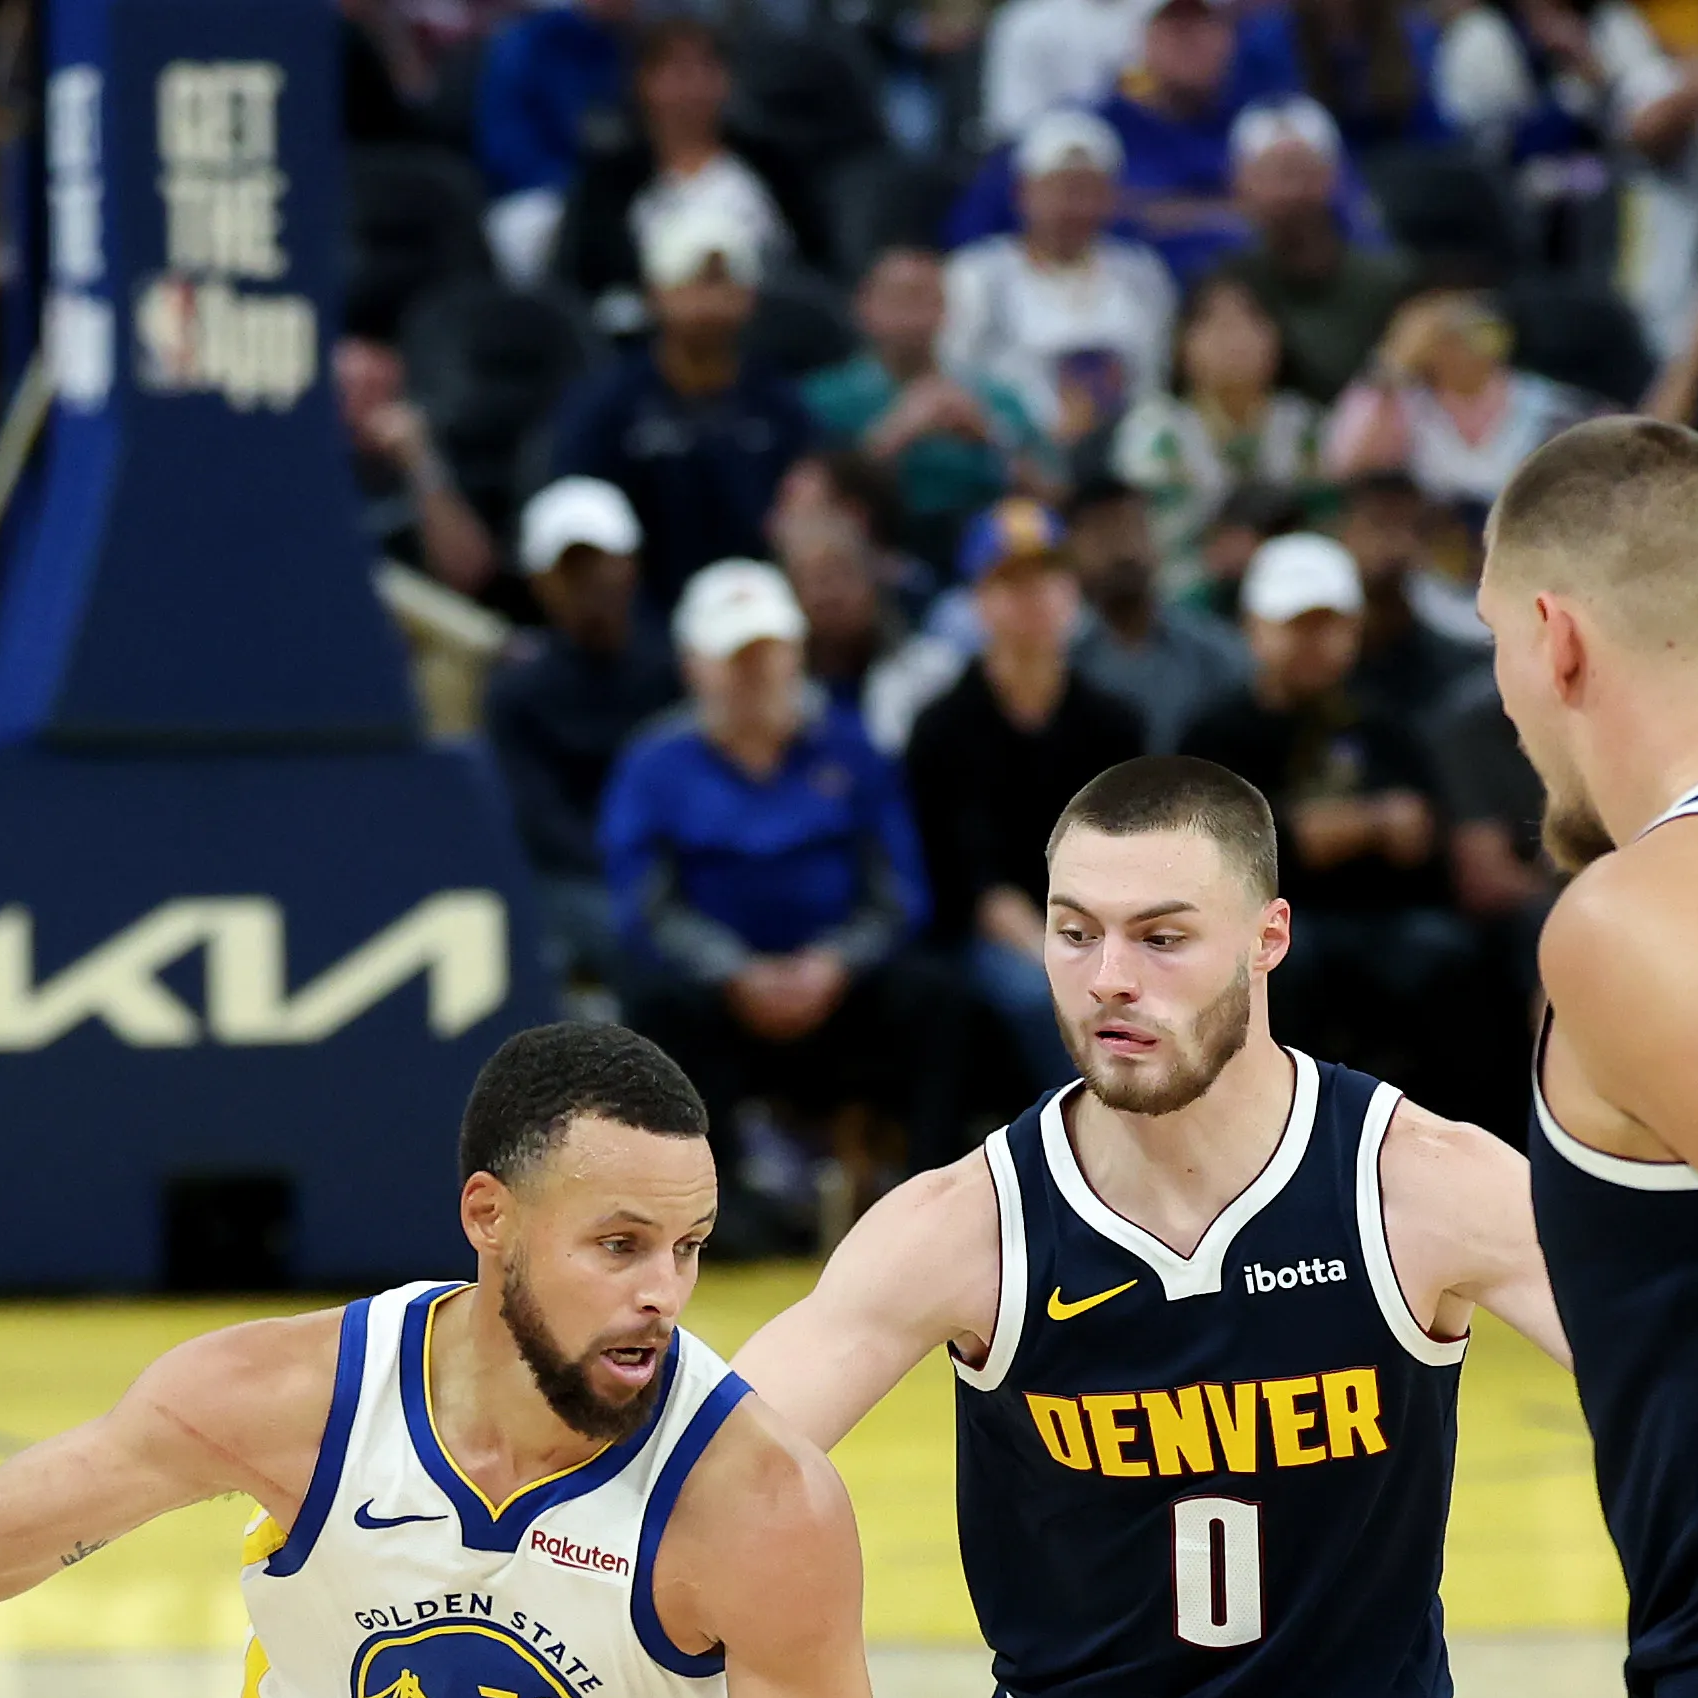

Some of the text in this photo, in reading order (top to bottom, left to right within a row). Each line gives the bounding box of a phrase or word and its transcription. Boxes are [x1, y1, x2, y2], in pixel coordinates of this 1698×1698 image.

[157, 60, 285, 162] GET
[156, 168, 289, 279] THE
[1244, 1257, 1347, 1295] ibotta
[1021, 1366, 1389, 1477] DENVER
[530, 1530, 629, 1577] Rakuten
[1171, 1494, 1264, 1648] 0
[355, 1593, 604, 1693] GOLDEN STATE
